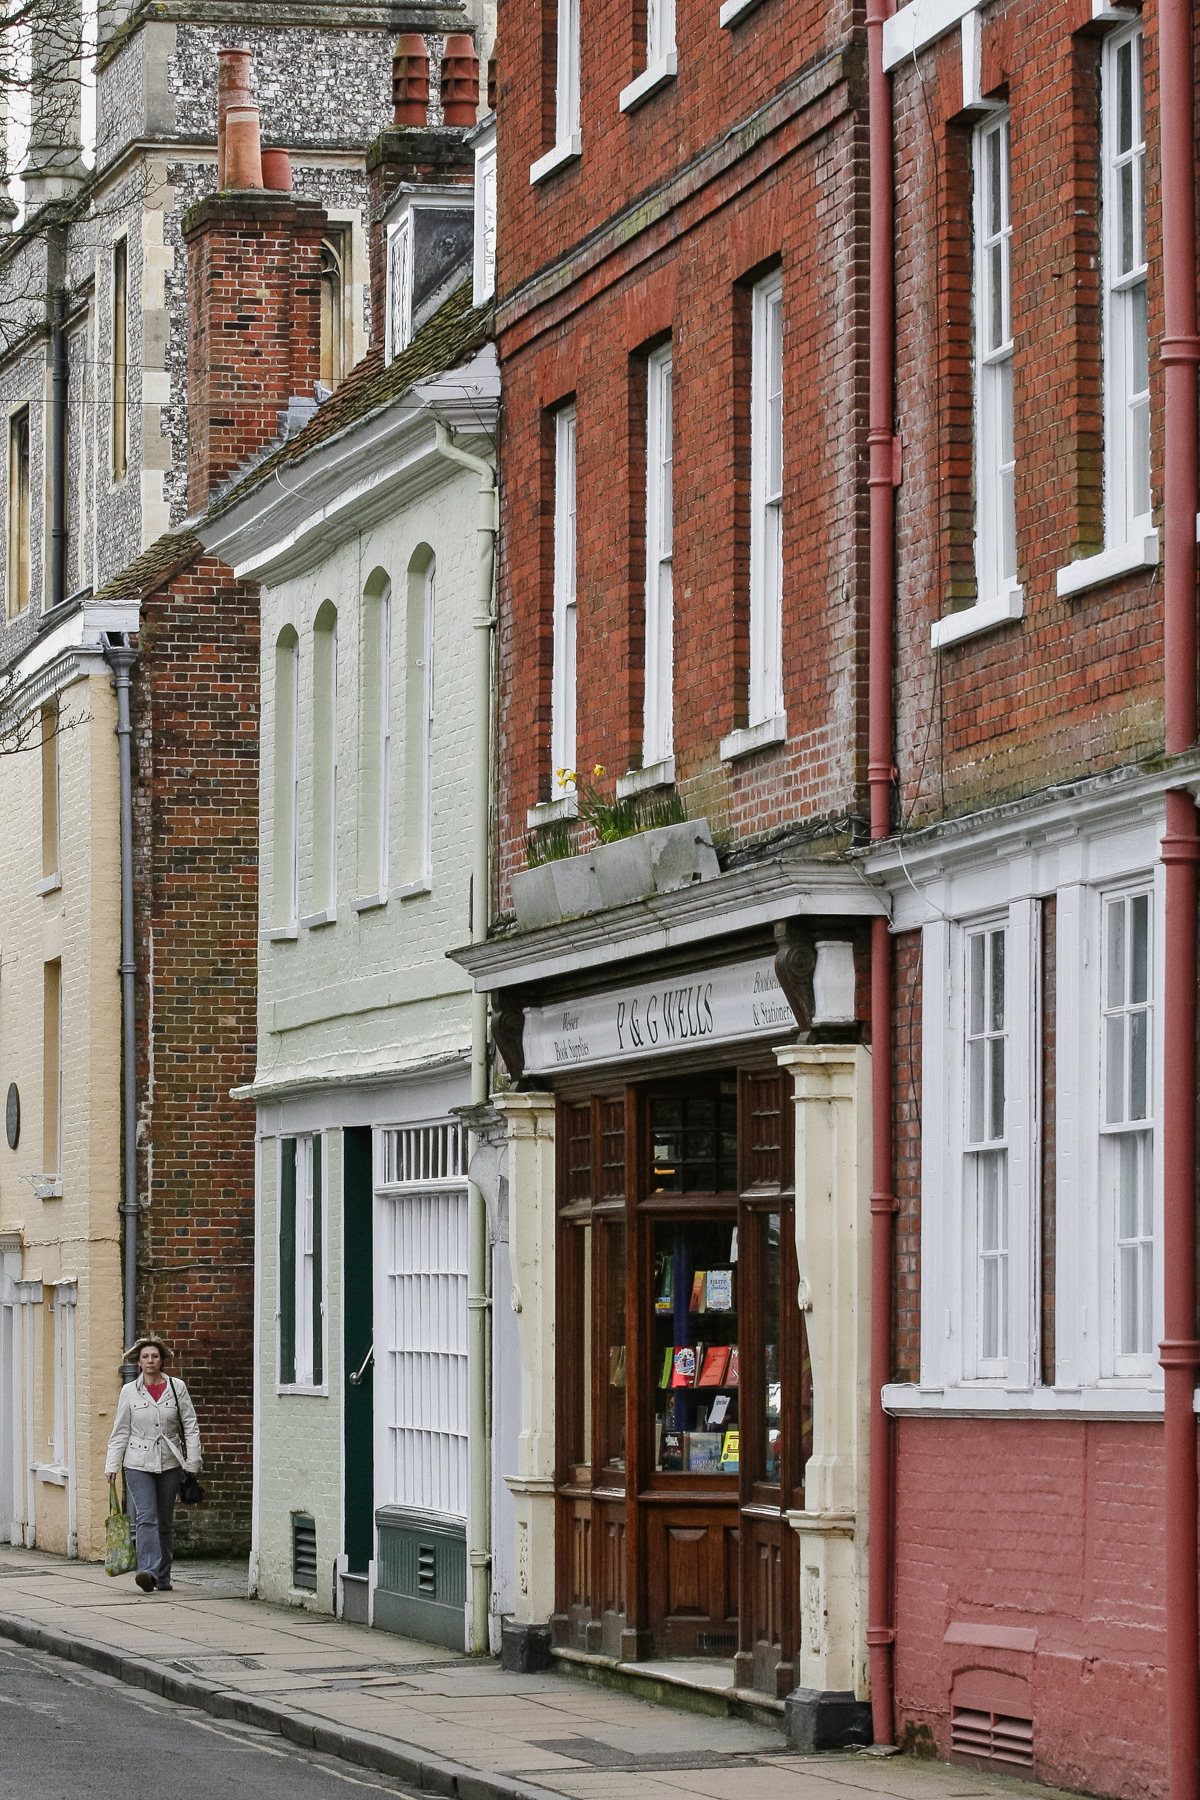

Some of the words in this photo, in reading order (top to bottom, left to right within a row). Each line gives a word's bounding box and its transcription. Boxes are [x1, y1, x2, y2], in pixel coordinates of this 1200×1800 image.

[616, 1001, 626, 1050] P
[629, 998, 644, 1048] &
[646, 994, 659, 1044] G
[663, 983, 714, 1041] WELLS
[752, 1003, 760, 1026] &
[760, 1001, 793, 1025] Stationers
[554, 1040, 569, 1062] Book
[568, 1037, 590, 1062] Supplies
